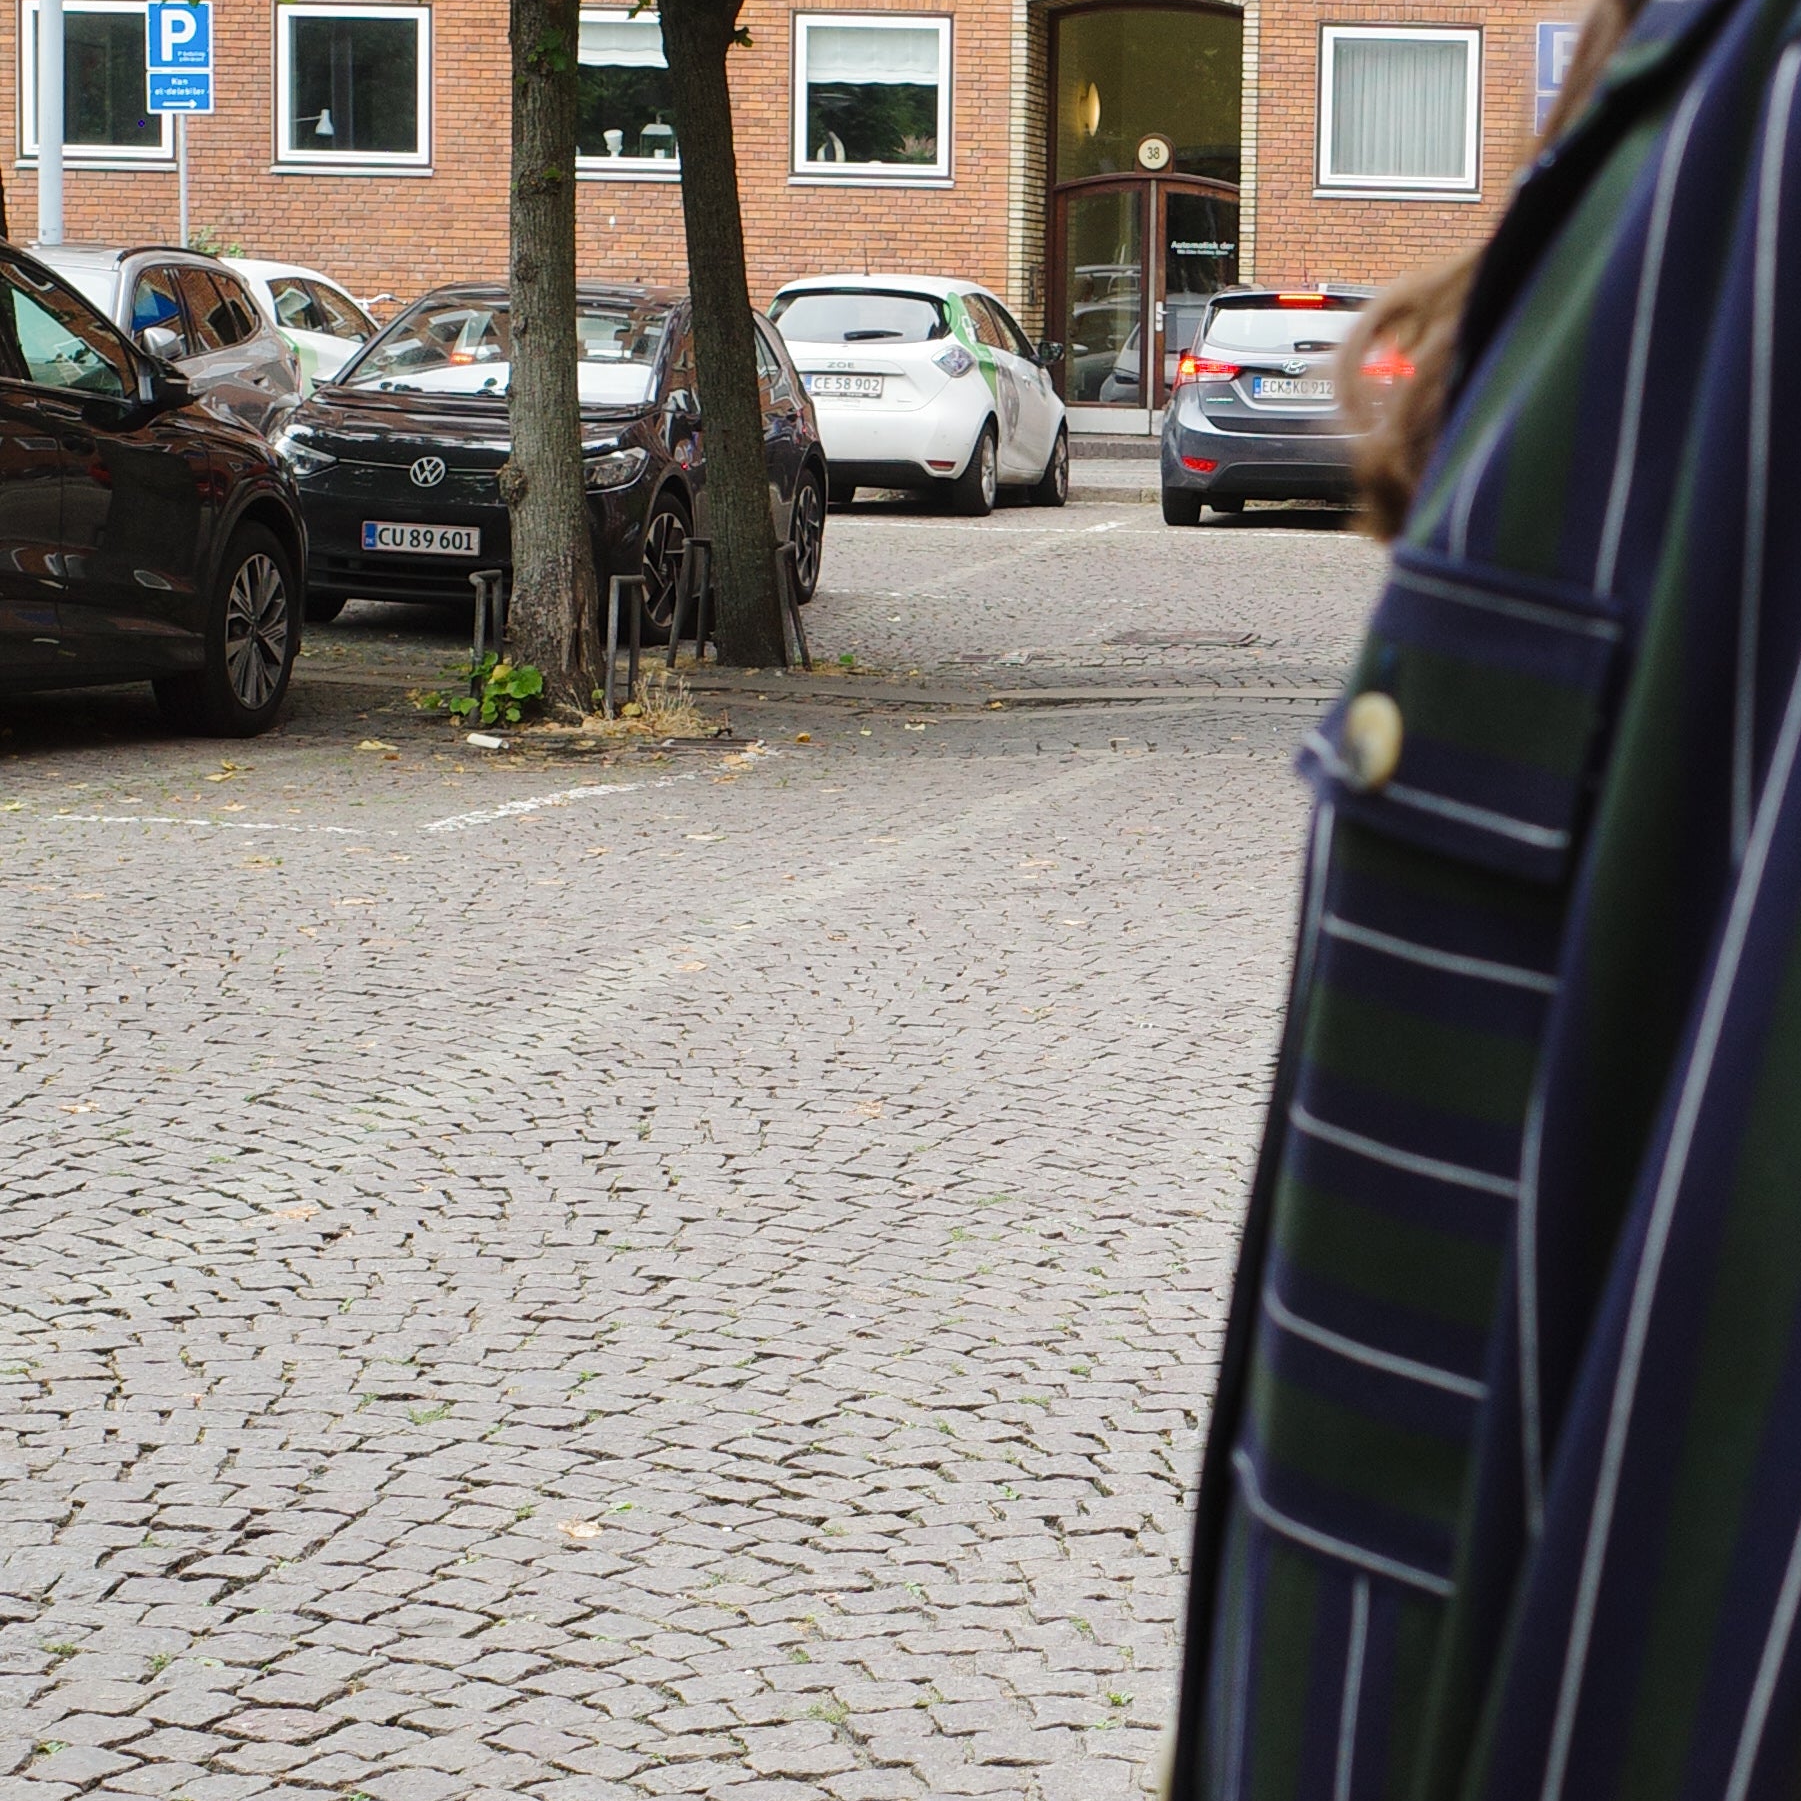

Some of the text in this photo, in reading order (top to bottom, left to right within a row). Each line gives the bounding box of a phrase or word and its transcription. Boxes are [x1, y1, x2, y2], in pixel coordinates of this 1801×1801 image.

[161, 9, 197, 62] P
[1147, 147, 1160, 160] 38
[827, 361, 855, 369] ZOE
[814, 377, 880, 391] CE 58 902
[1262, 380, 1285, 393] ECK
[1311, 381, 1333, 395] 912
[378, 527, 473, 551] CU 89 601
